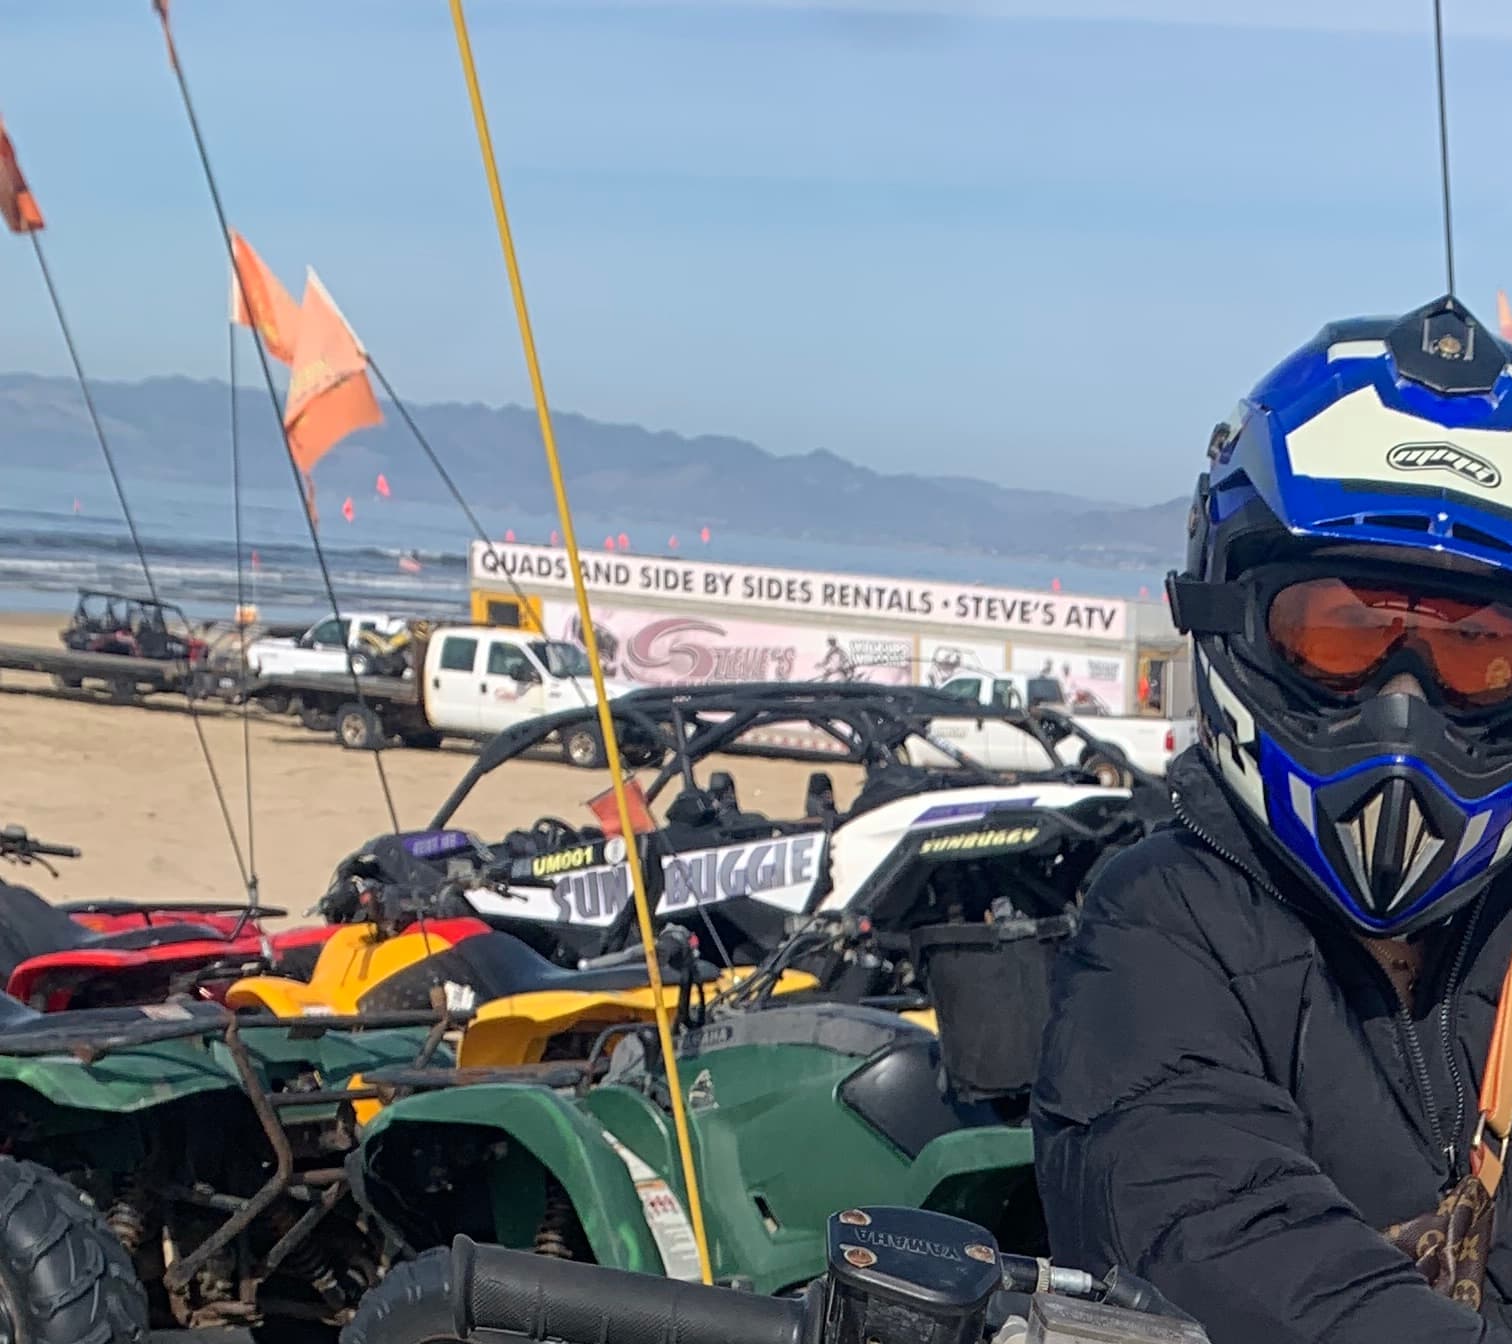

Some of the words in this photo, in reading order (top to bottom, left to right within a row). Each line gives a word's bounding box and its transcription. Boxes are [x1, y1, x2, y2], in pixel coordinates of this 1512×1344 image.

[481, 549, 567, 579] QUADS
[578, 556, 630, 586] AND
[639, 565, 694, 593] SIDE
[703, 572, 735, 596] BY
[742, 575, 814, 603] SIDES
[822, 582, 933, 614] RENTALS
[955, 593, 1055, 626] STEVE'S
[1065, 605, 1117, 631] ATV
[532, 845, 594, 877] UM001
[552, 864, 629, 922] SUN
[664, 838, 815, 906] BUGGIE
[854, 1227, 962, 1263] YAMAHA
